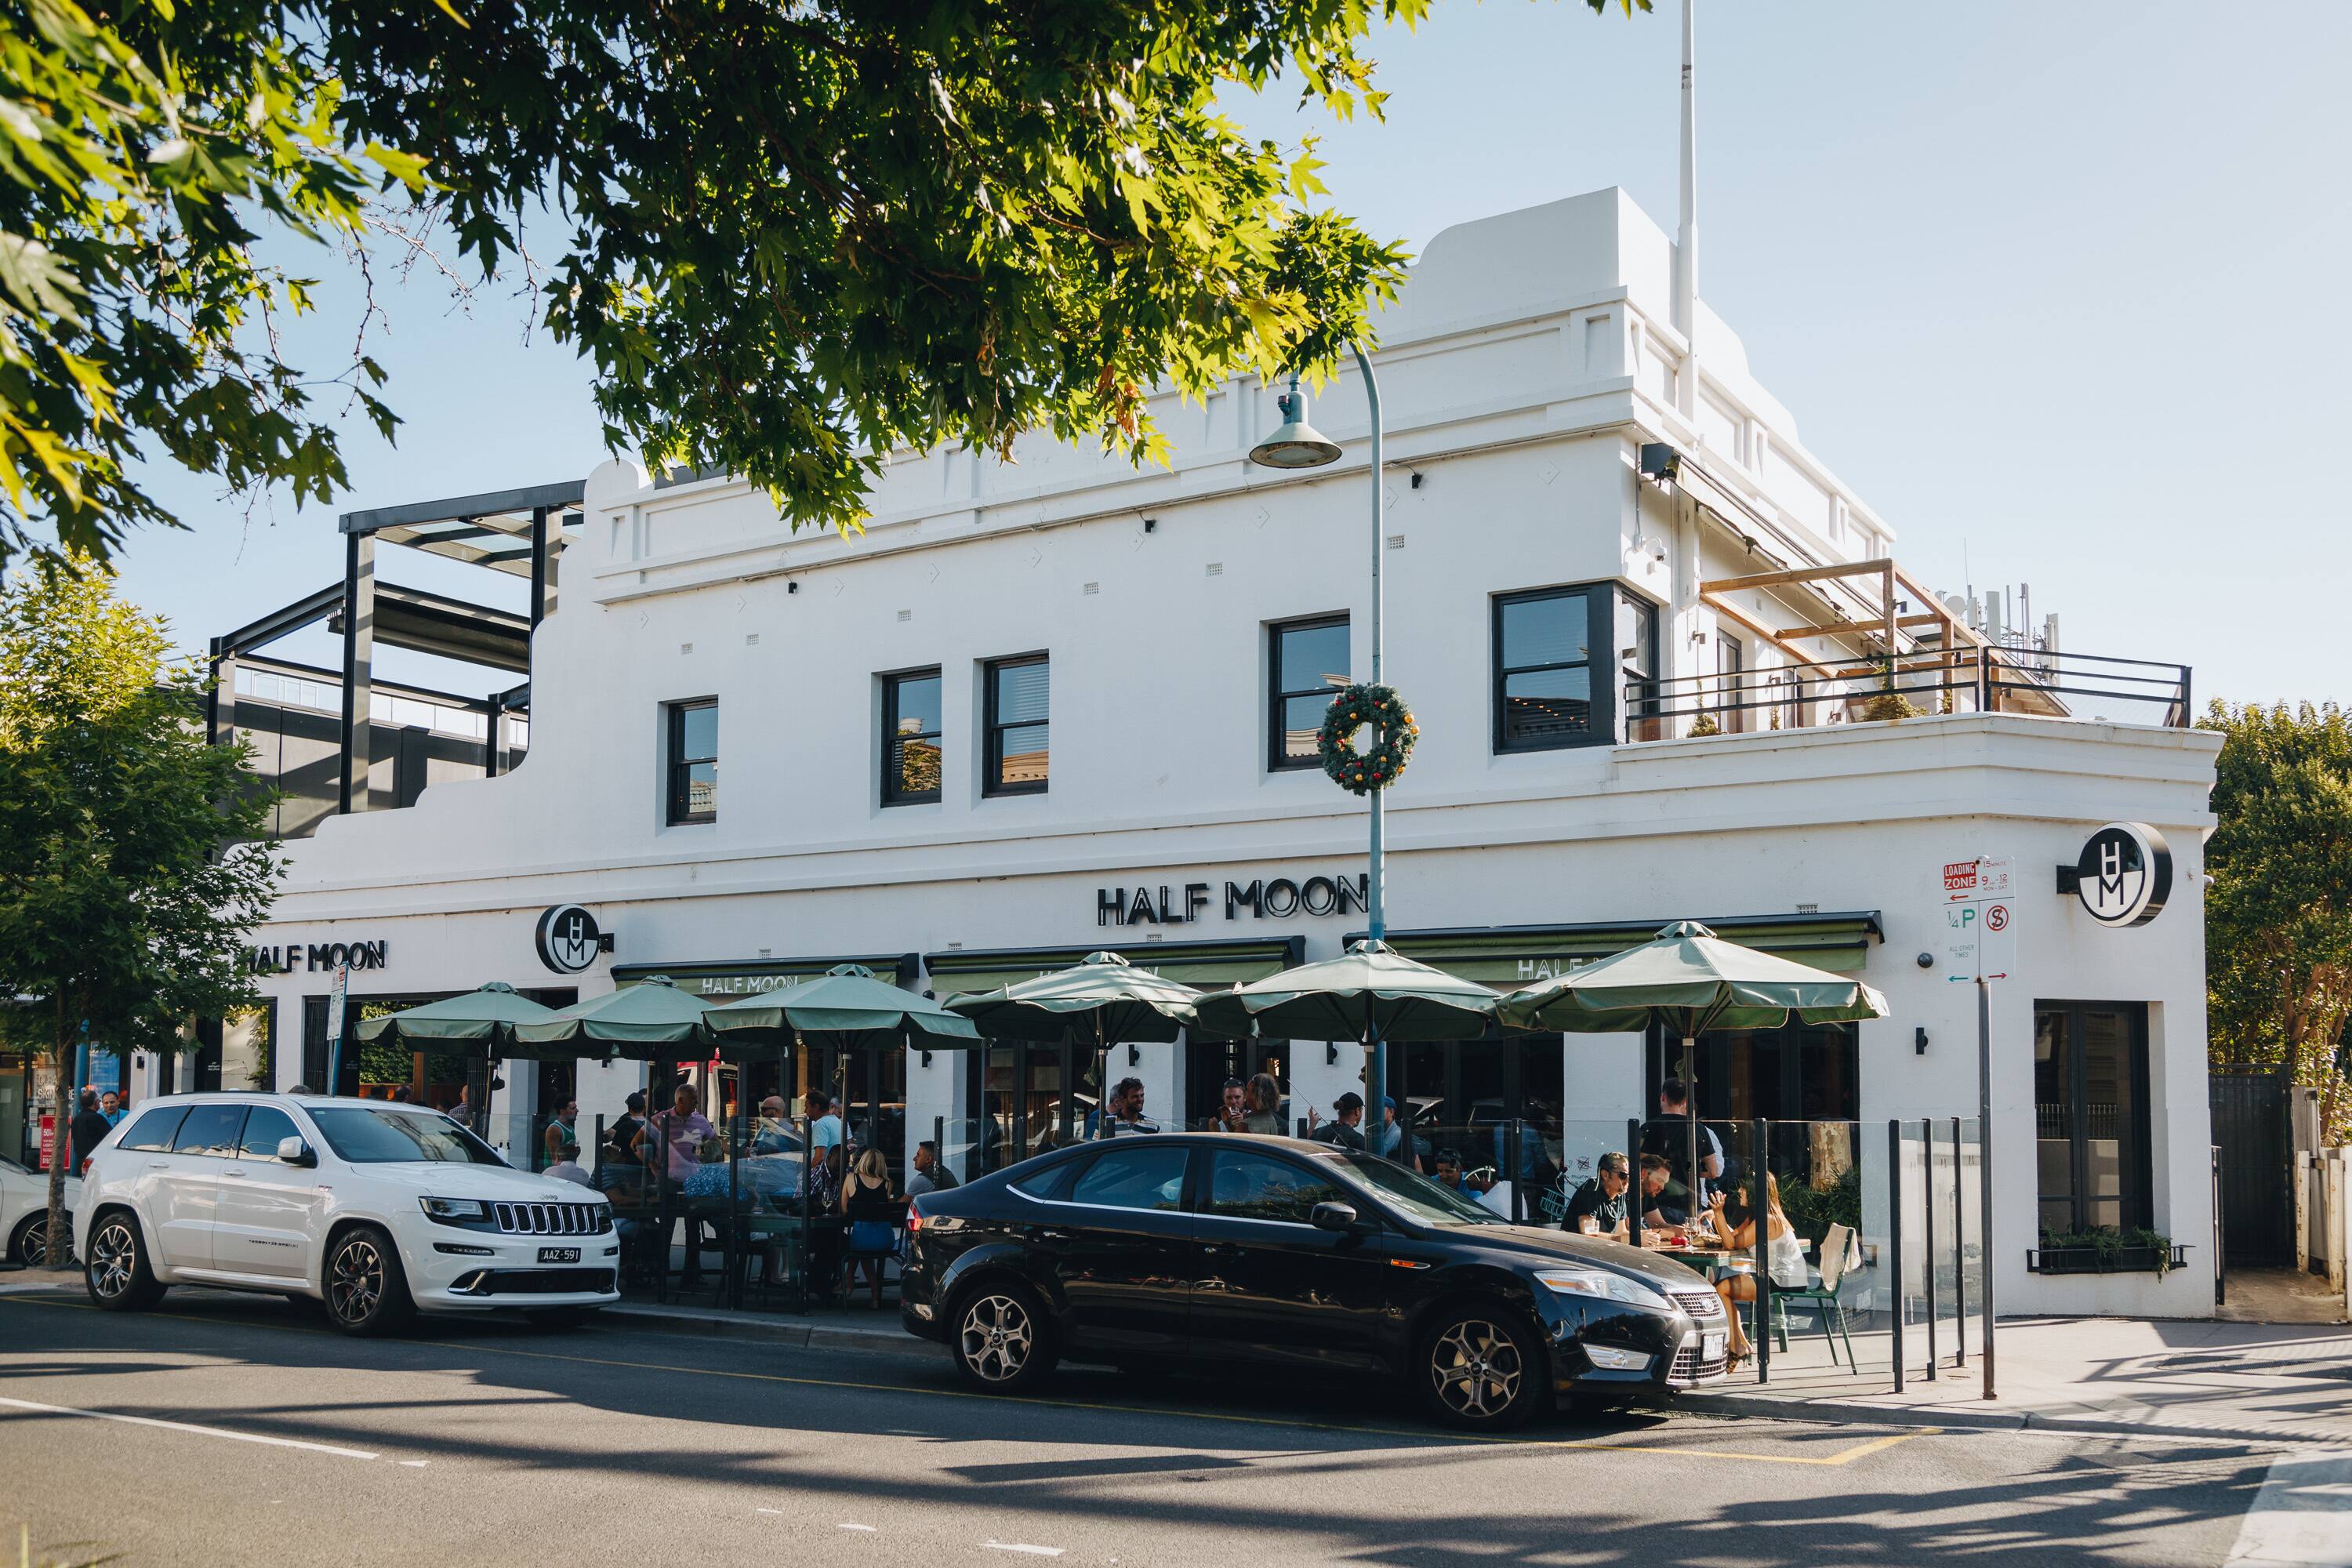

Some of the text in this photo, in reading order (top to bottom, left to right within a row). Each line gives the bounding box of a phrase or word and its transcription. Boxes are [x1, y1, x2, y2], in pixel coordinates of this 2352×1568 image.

[1944, 863, 1975, 877] LOADING
[1944, 877, 1976, 889] ZONE
[1098, 873, 1369, 926] HALF MOON
[1962, 909, 1976, 928] P
[307, 940, 386, 972] MOON
[702, 975, 798, 994] HALF MOON
